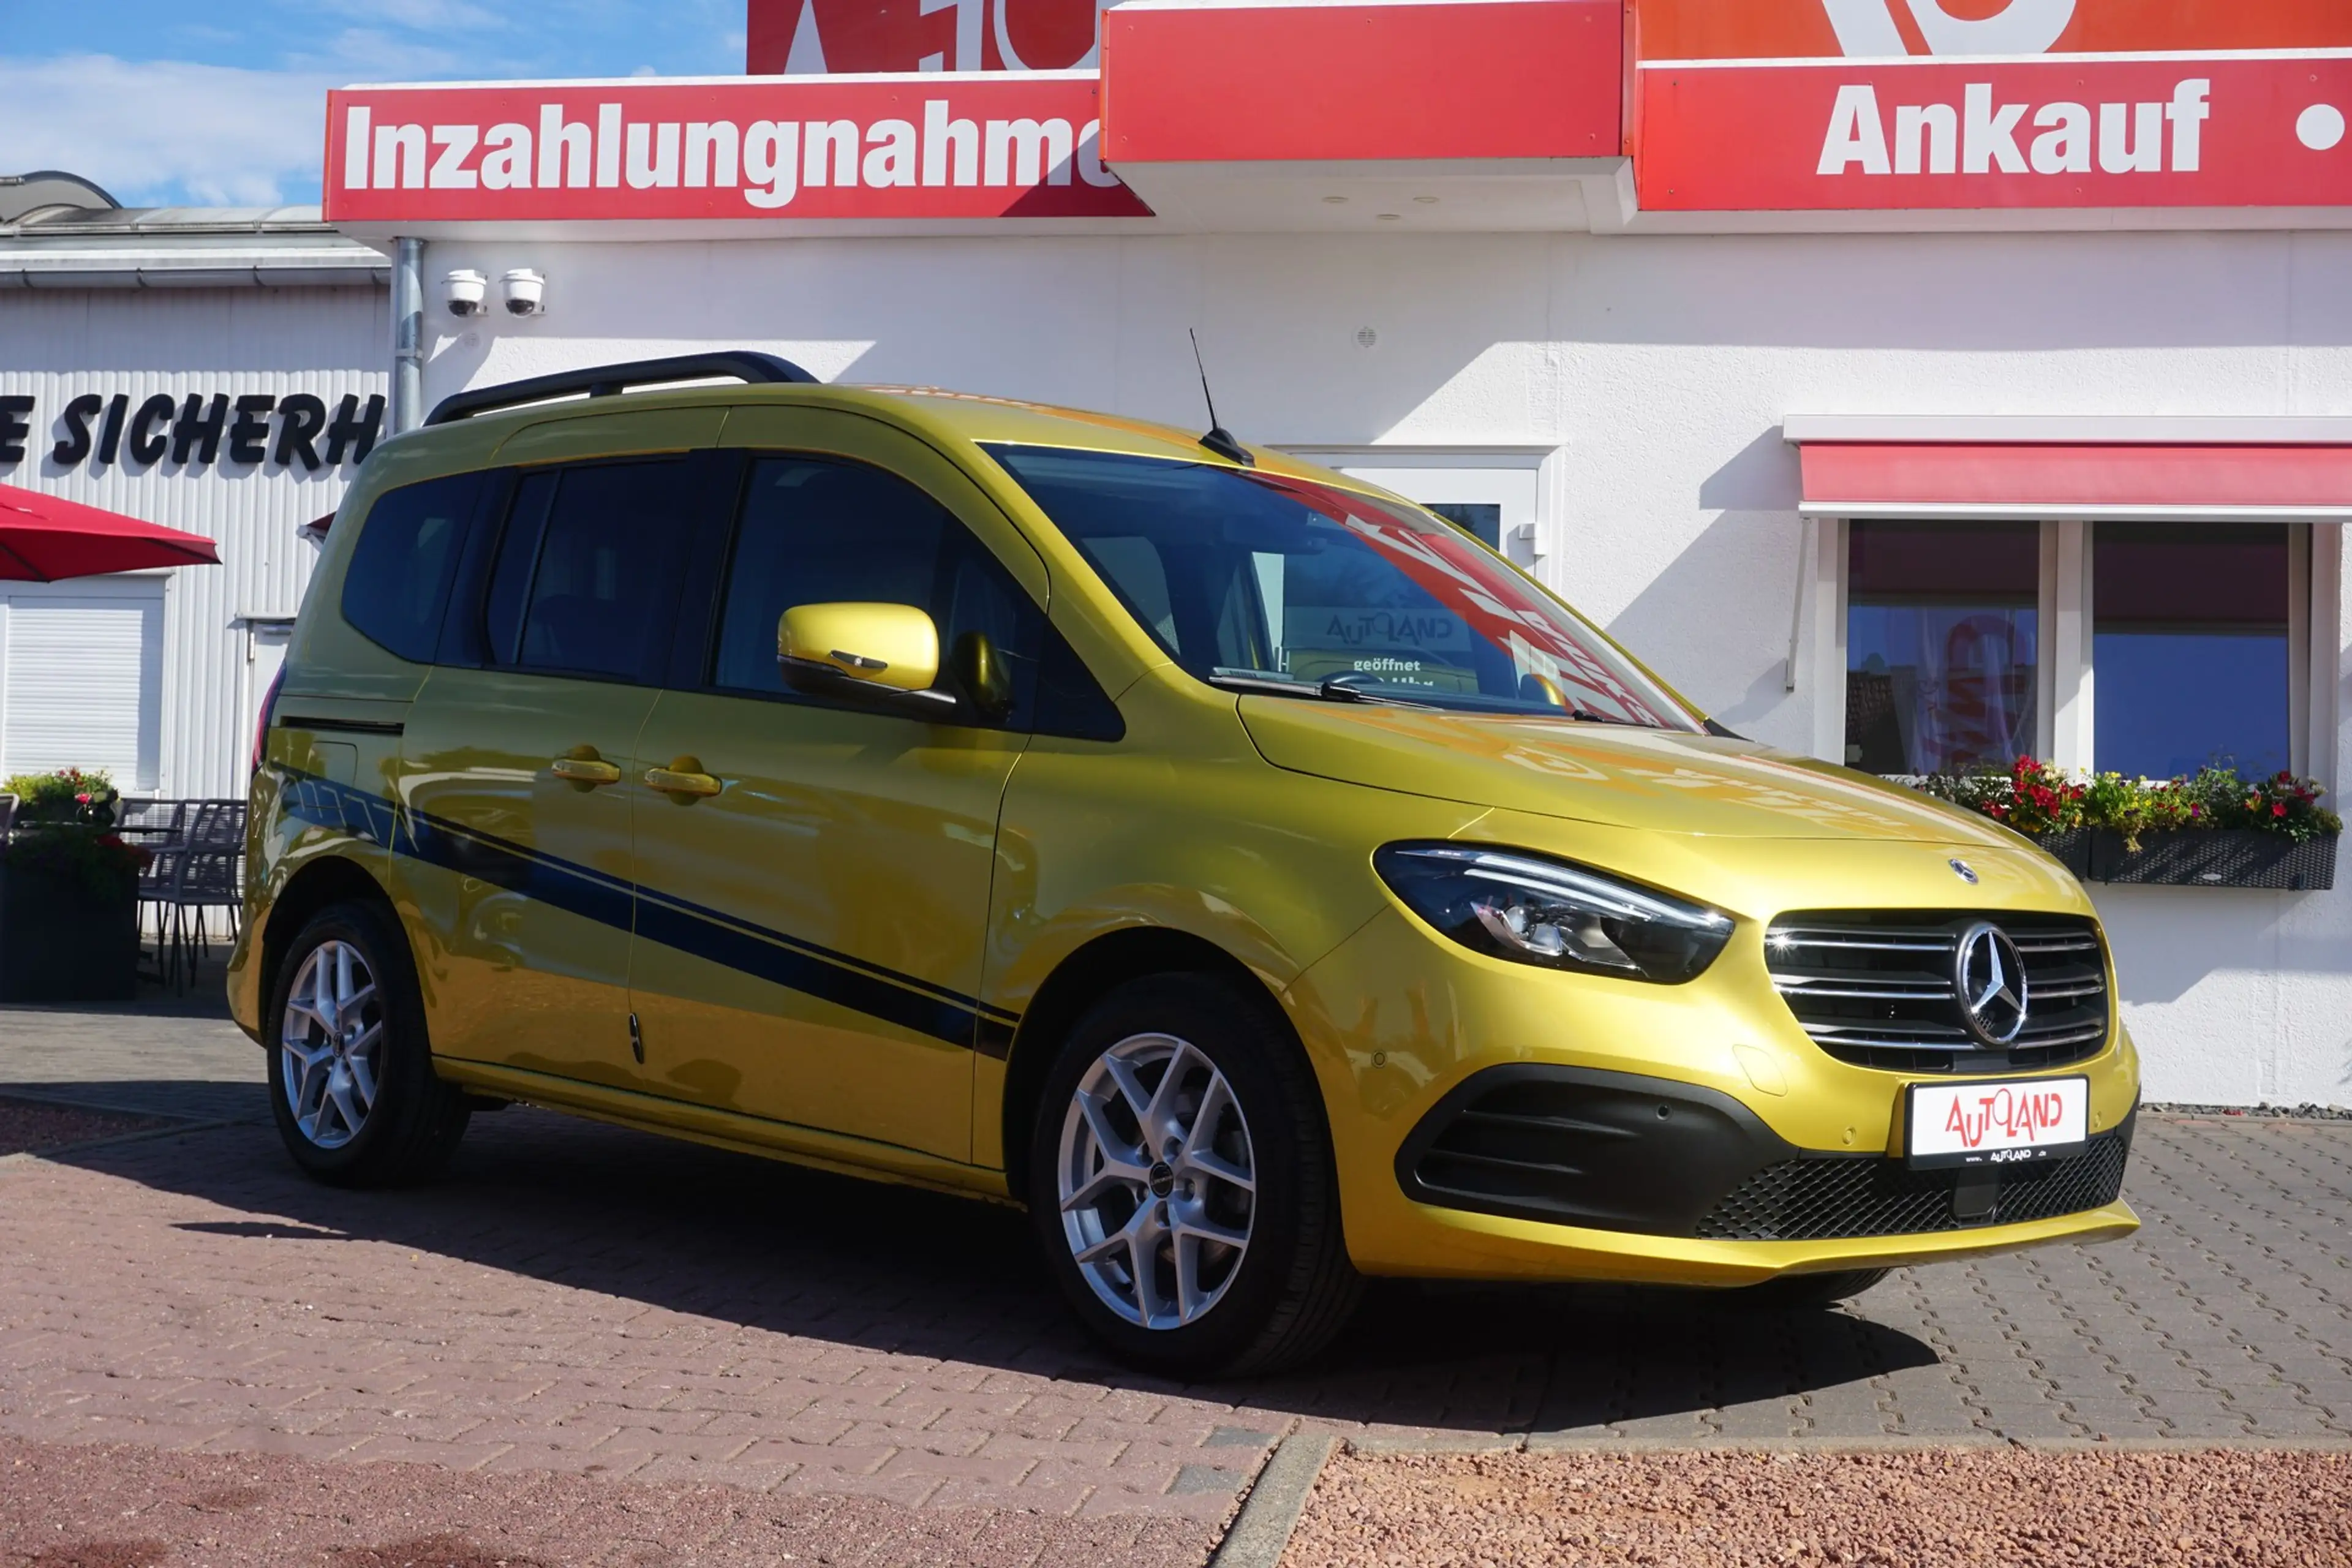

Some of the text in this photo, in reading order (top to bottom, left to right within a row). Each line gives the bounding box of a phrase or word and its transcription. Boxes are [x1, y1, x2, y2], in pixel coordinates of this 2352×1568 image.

[1815, 78, 2211, 175] Ankauf
[53, 393, 386, 472] SICHERH
[1354, 658, 1420, 672] geöffnet
[1945, 1088, 2063, 1147] AUTOLAND
[1990, 1148, 2032, 1163] AUTOLAND
